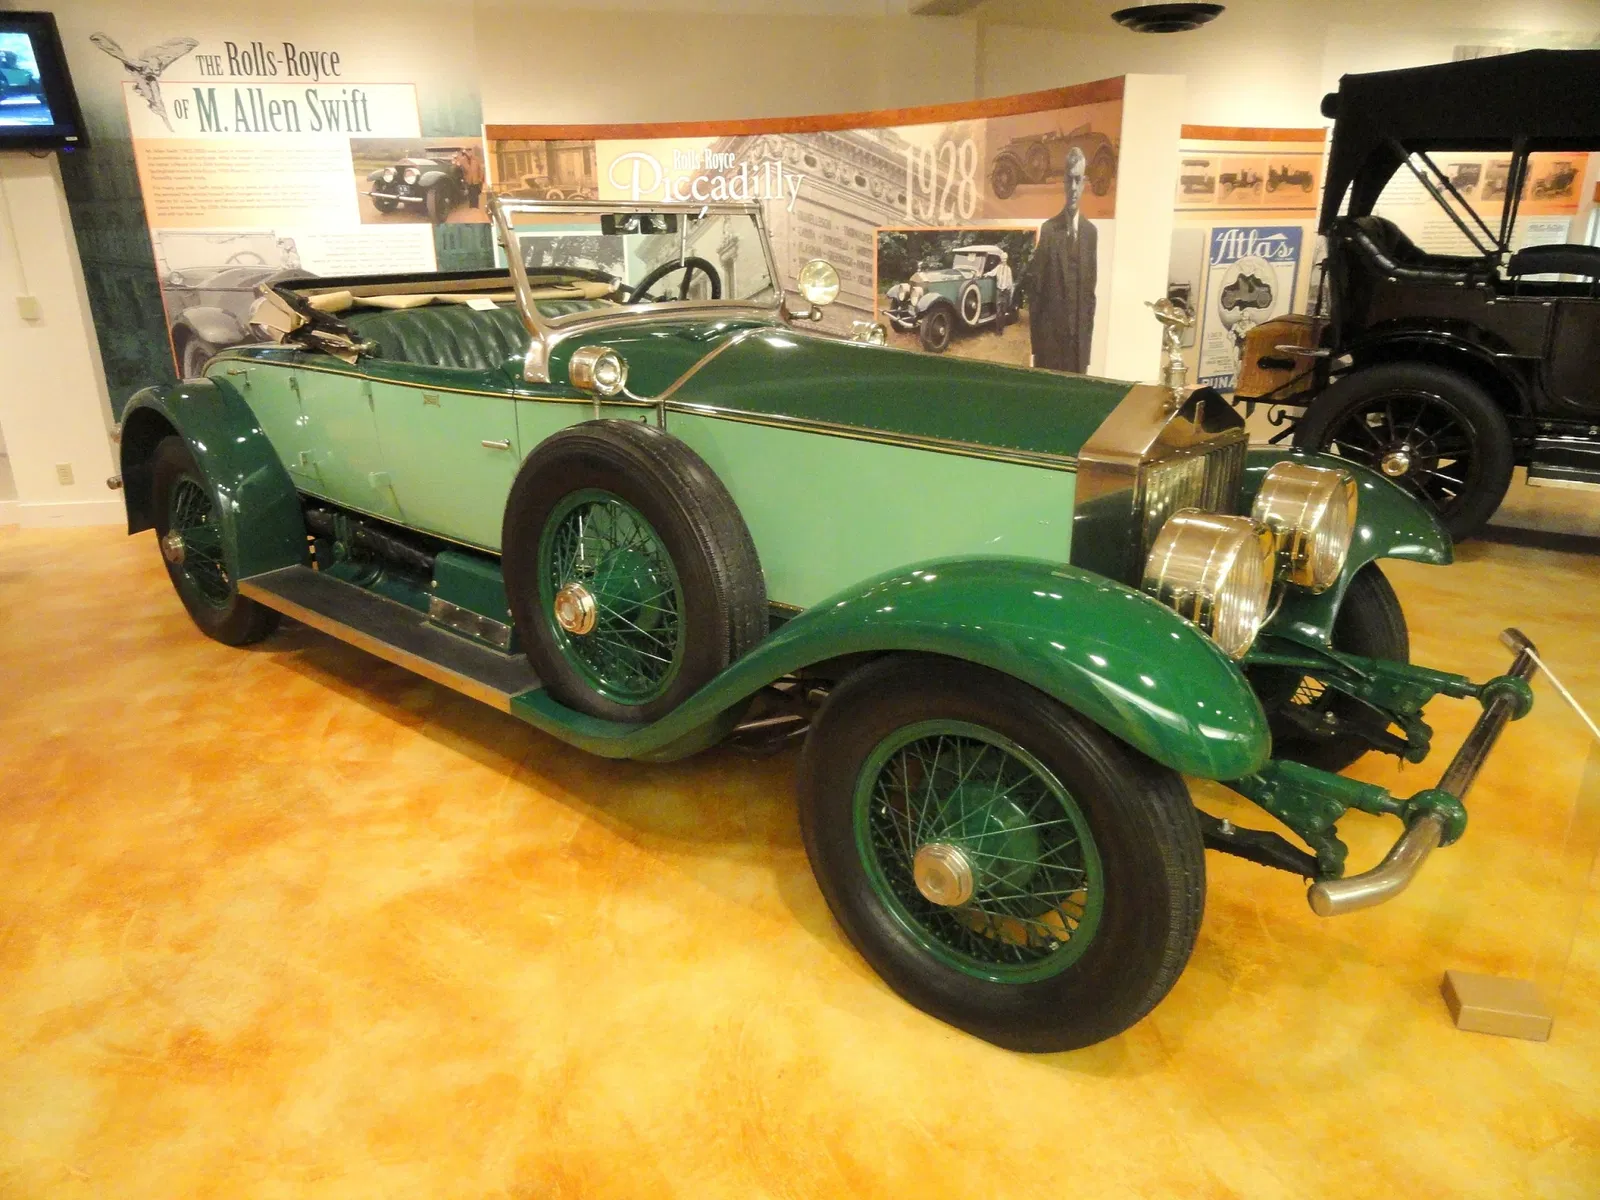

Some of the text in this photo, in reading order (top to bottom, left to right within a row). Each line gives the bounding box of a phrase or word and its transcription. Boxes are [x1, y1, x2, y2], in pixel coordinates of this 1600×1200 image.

[195, 41, 341, 82] THE Rolls-Royce
[174, 87, 372, 132] OF M. Allen Swift
[608, 151, 805, 212] Piccadilly
[672, 148, 736, 174] Rolls-Royce
[903, 138, 978, 220] 1928
[1210, 229, 1295, 265] Atlas
[1202, 375, 1236, 389] RUNA
